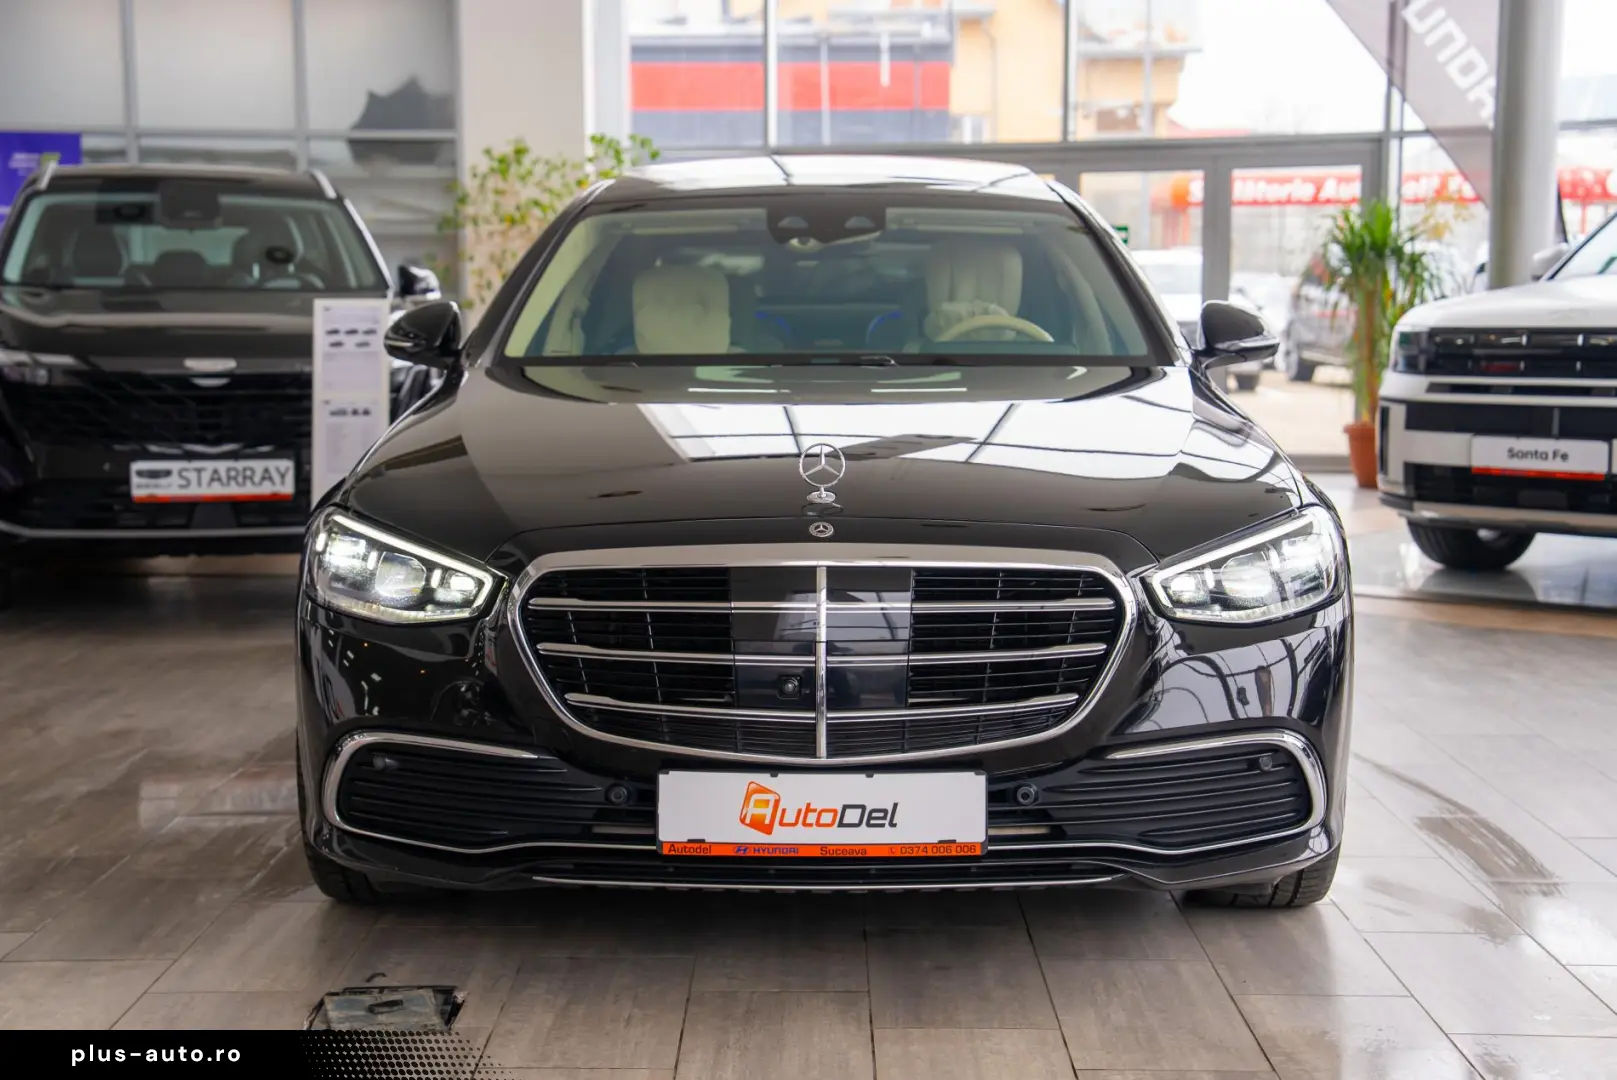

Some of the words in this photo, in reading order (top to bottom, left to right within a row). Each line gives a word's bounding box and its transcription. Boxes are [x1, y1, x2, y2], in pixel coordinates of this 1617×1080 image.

[1507, 447, 1549, 461] Santa
[1553, 449, 1569, 462] Fe
[177, 466, 290, 489] STARRAY
[743, 788, 899, 831] AutoDel
[668, 843, 712, 855] Autodel
[753, 847, 799, 855] HYUNDAI
[819, 846, 867, 856] Suceava
[900, 846, 928, 856] 0374
[931, 845, 952, 855] 006
[955, 844, 977, 854] 006
